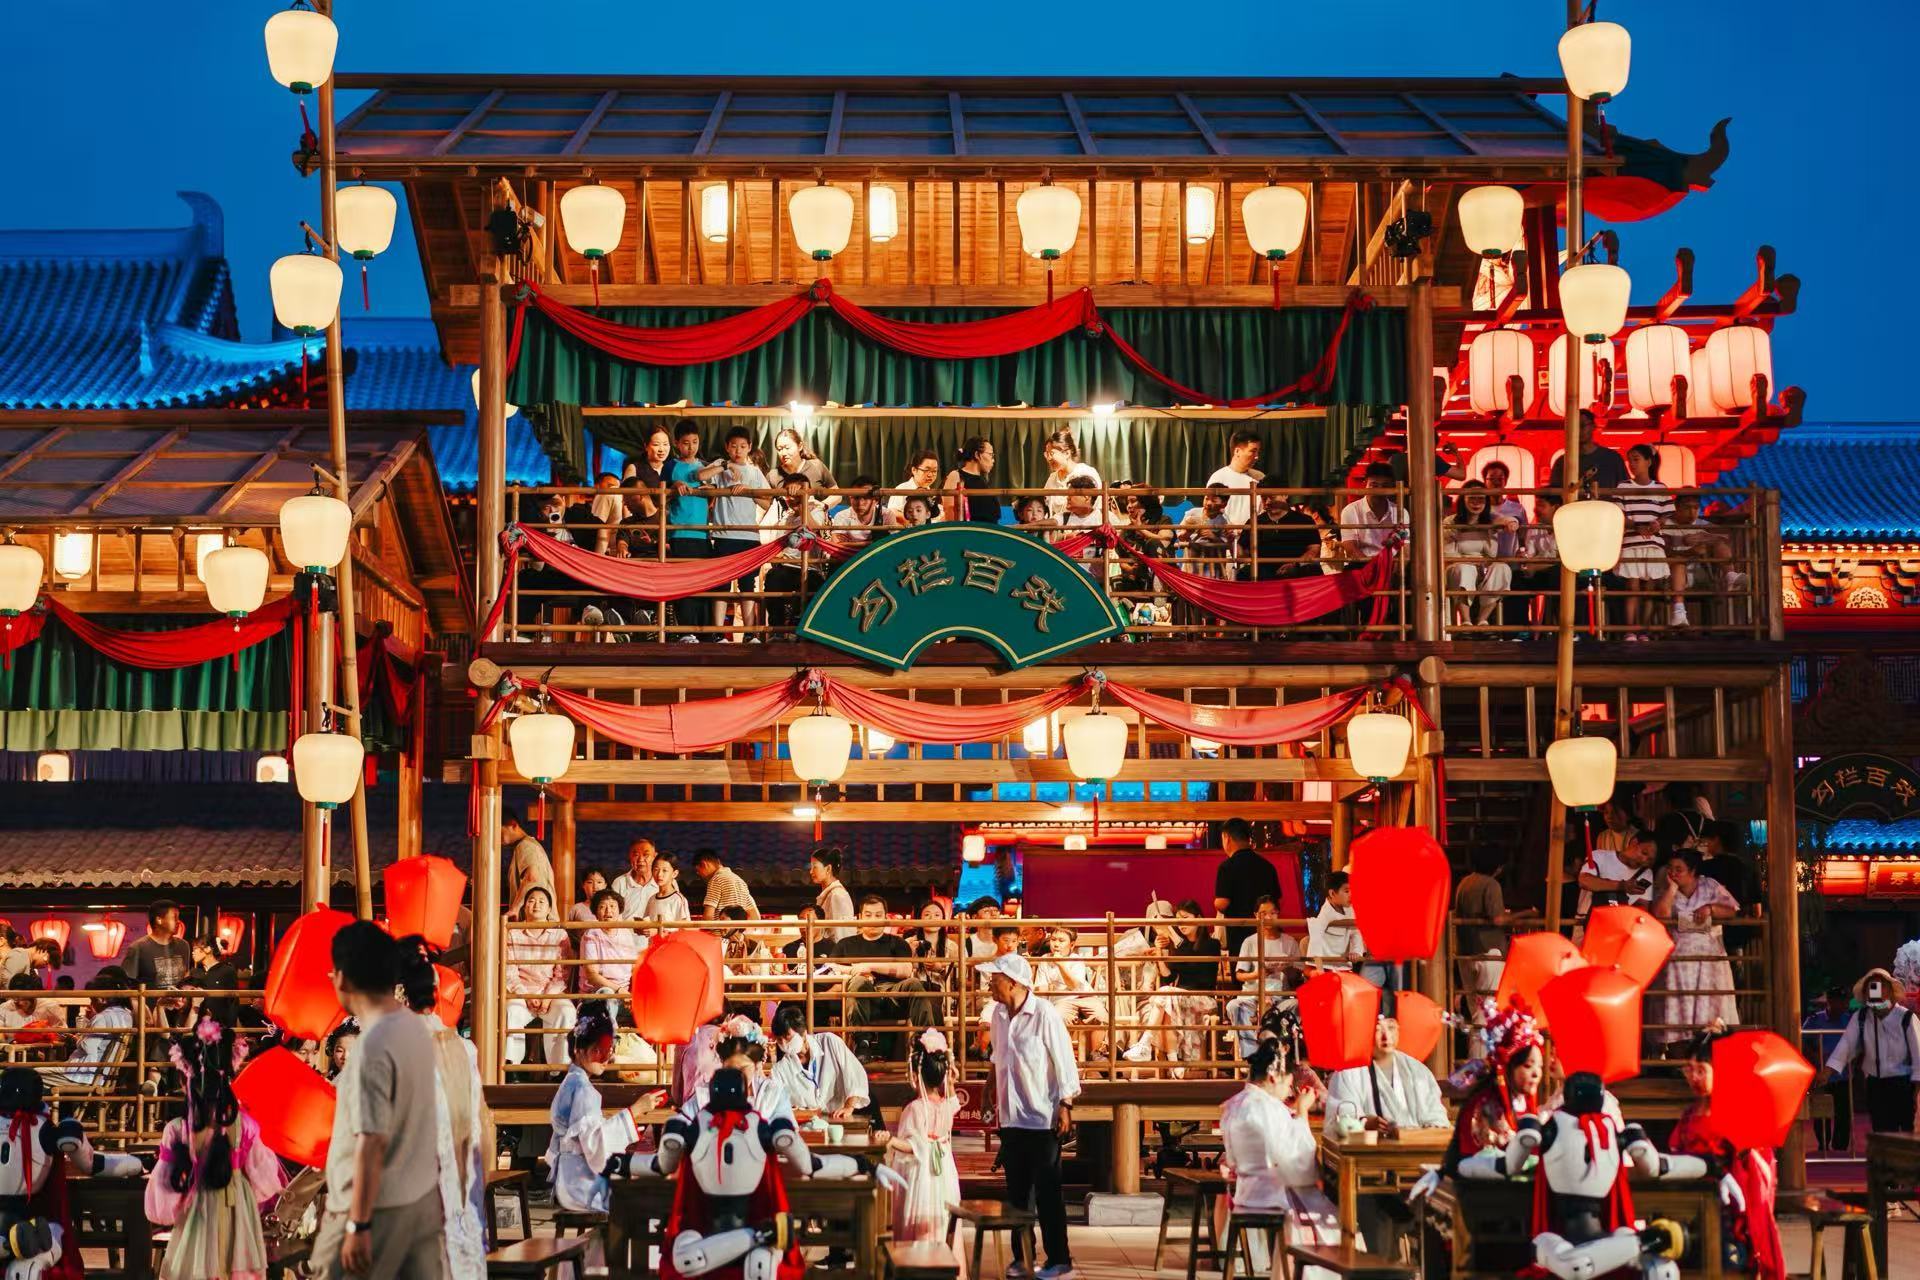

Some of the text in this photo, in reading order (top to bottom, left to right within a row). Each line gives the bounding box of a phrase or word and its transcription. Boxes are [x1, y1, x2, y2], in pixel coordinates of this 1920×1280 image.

[850, 549, 1066, 632] 勾栏百戏
[953, 1109, 982, 1120] 翻越
